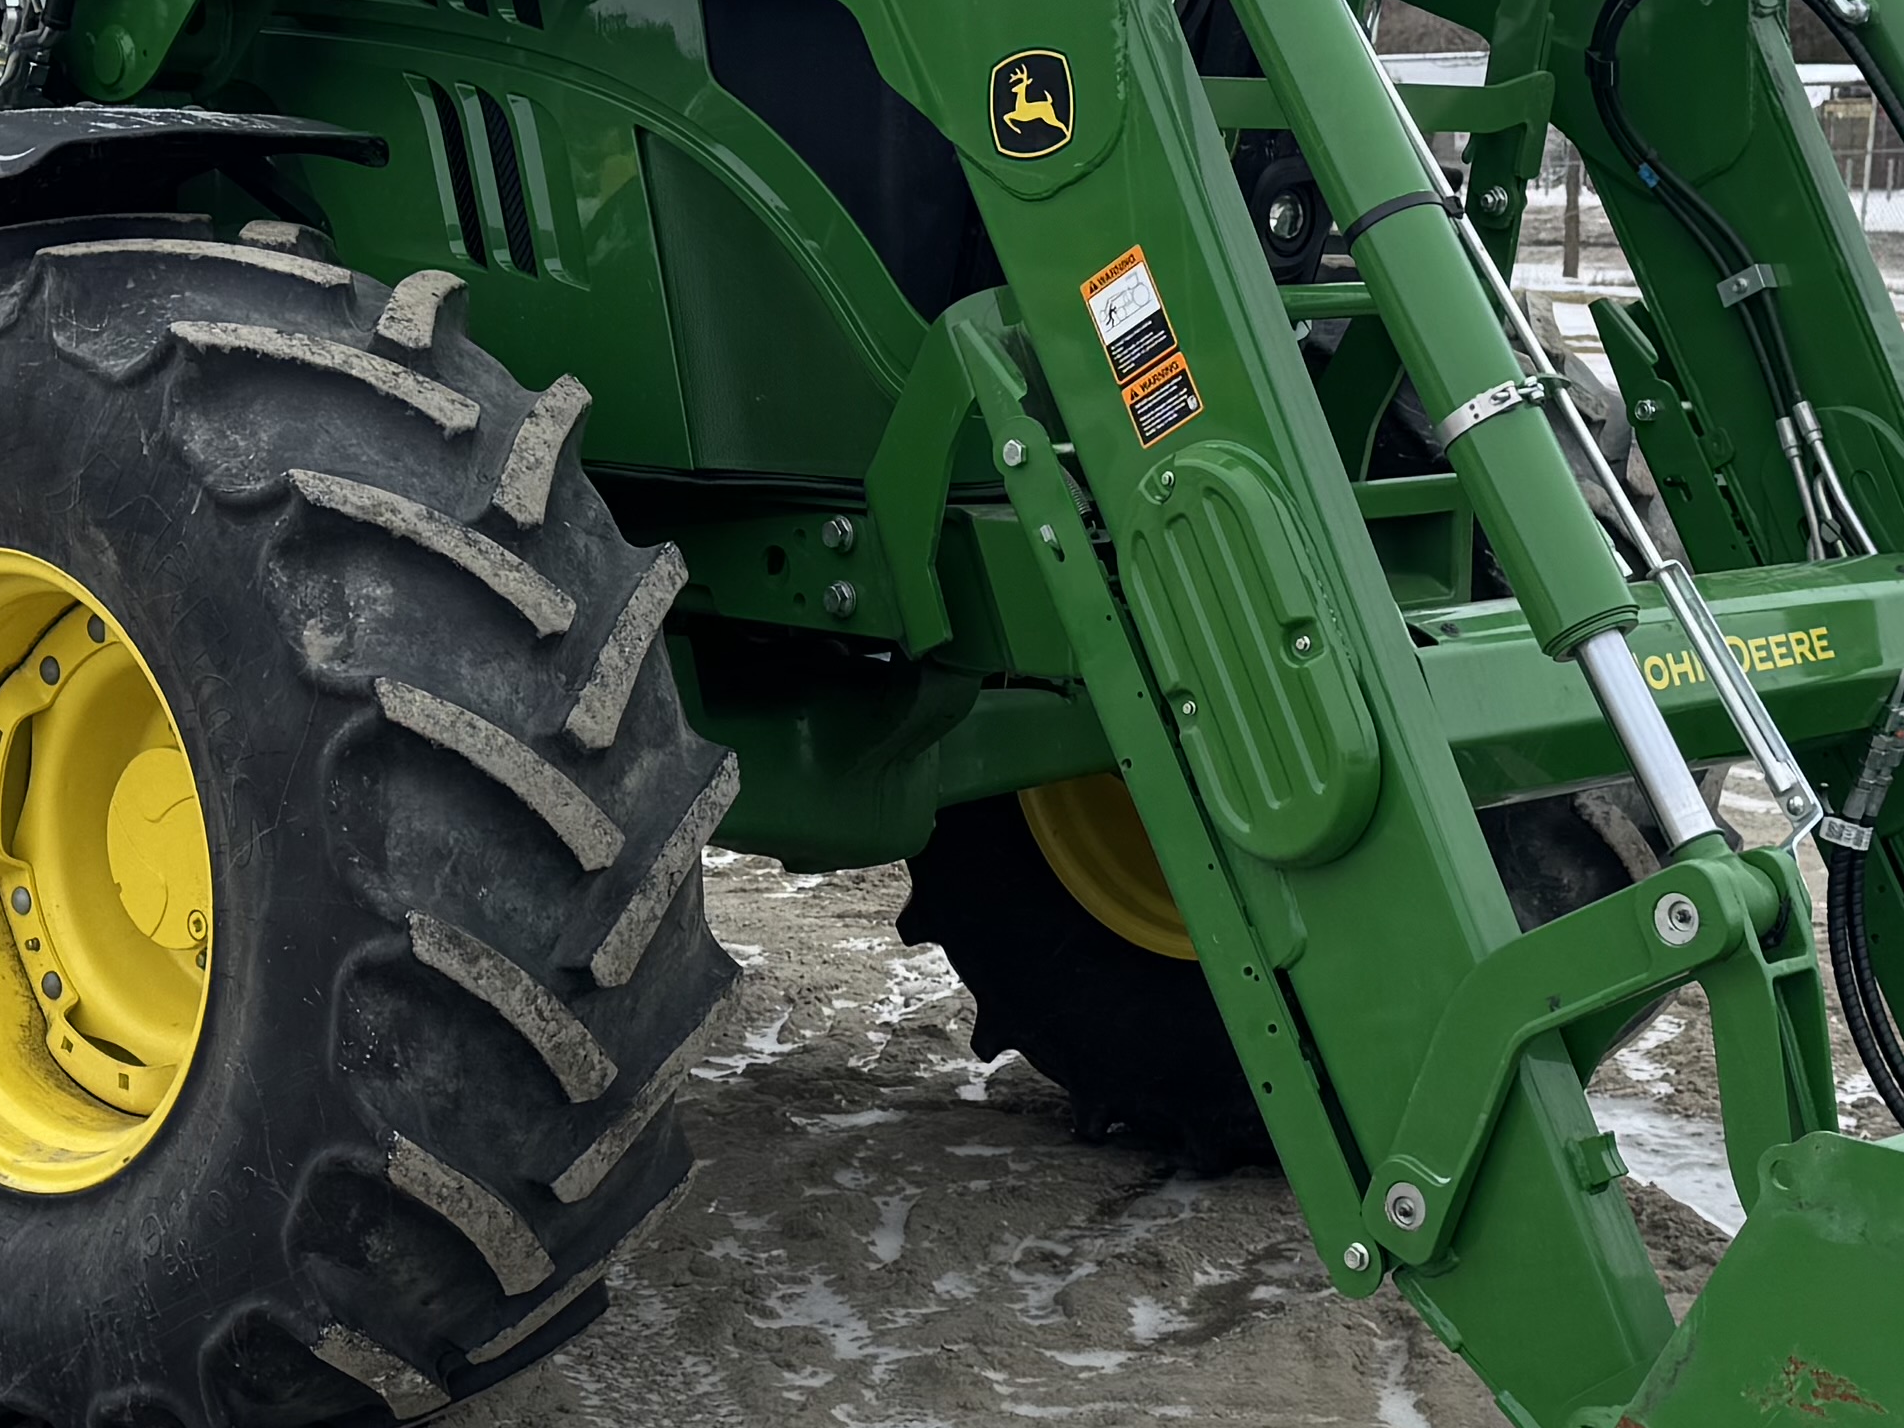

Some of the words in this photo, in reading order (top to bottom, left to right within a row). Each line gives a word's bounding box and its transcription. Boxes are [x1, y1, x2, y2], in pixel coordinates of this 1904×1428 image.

[1096, 253, 1137, 286] WARNING
[1139, 360, 1180, 392] WARNING
[1633, 648, 1706, 690] OH
[1725, 626, 1836, 674] DEERE
